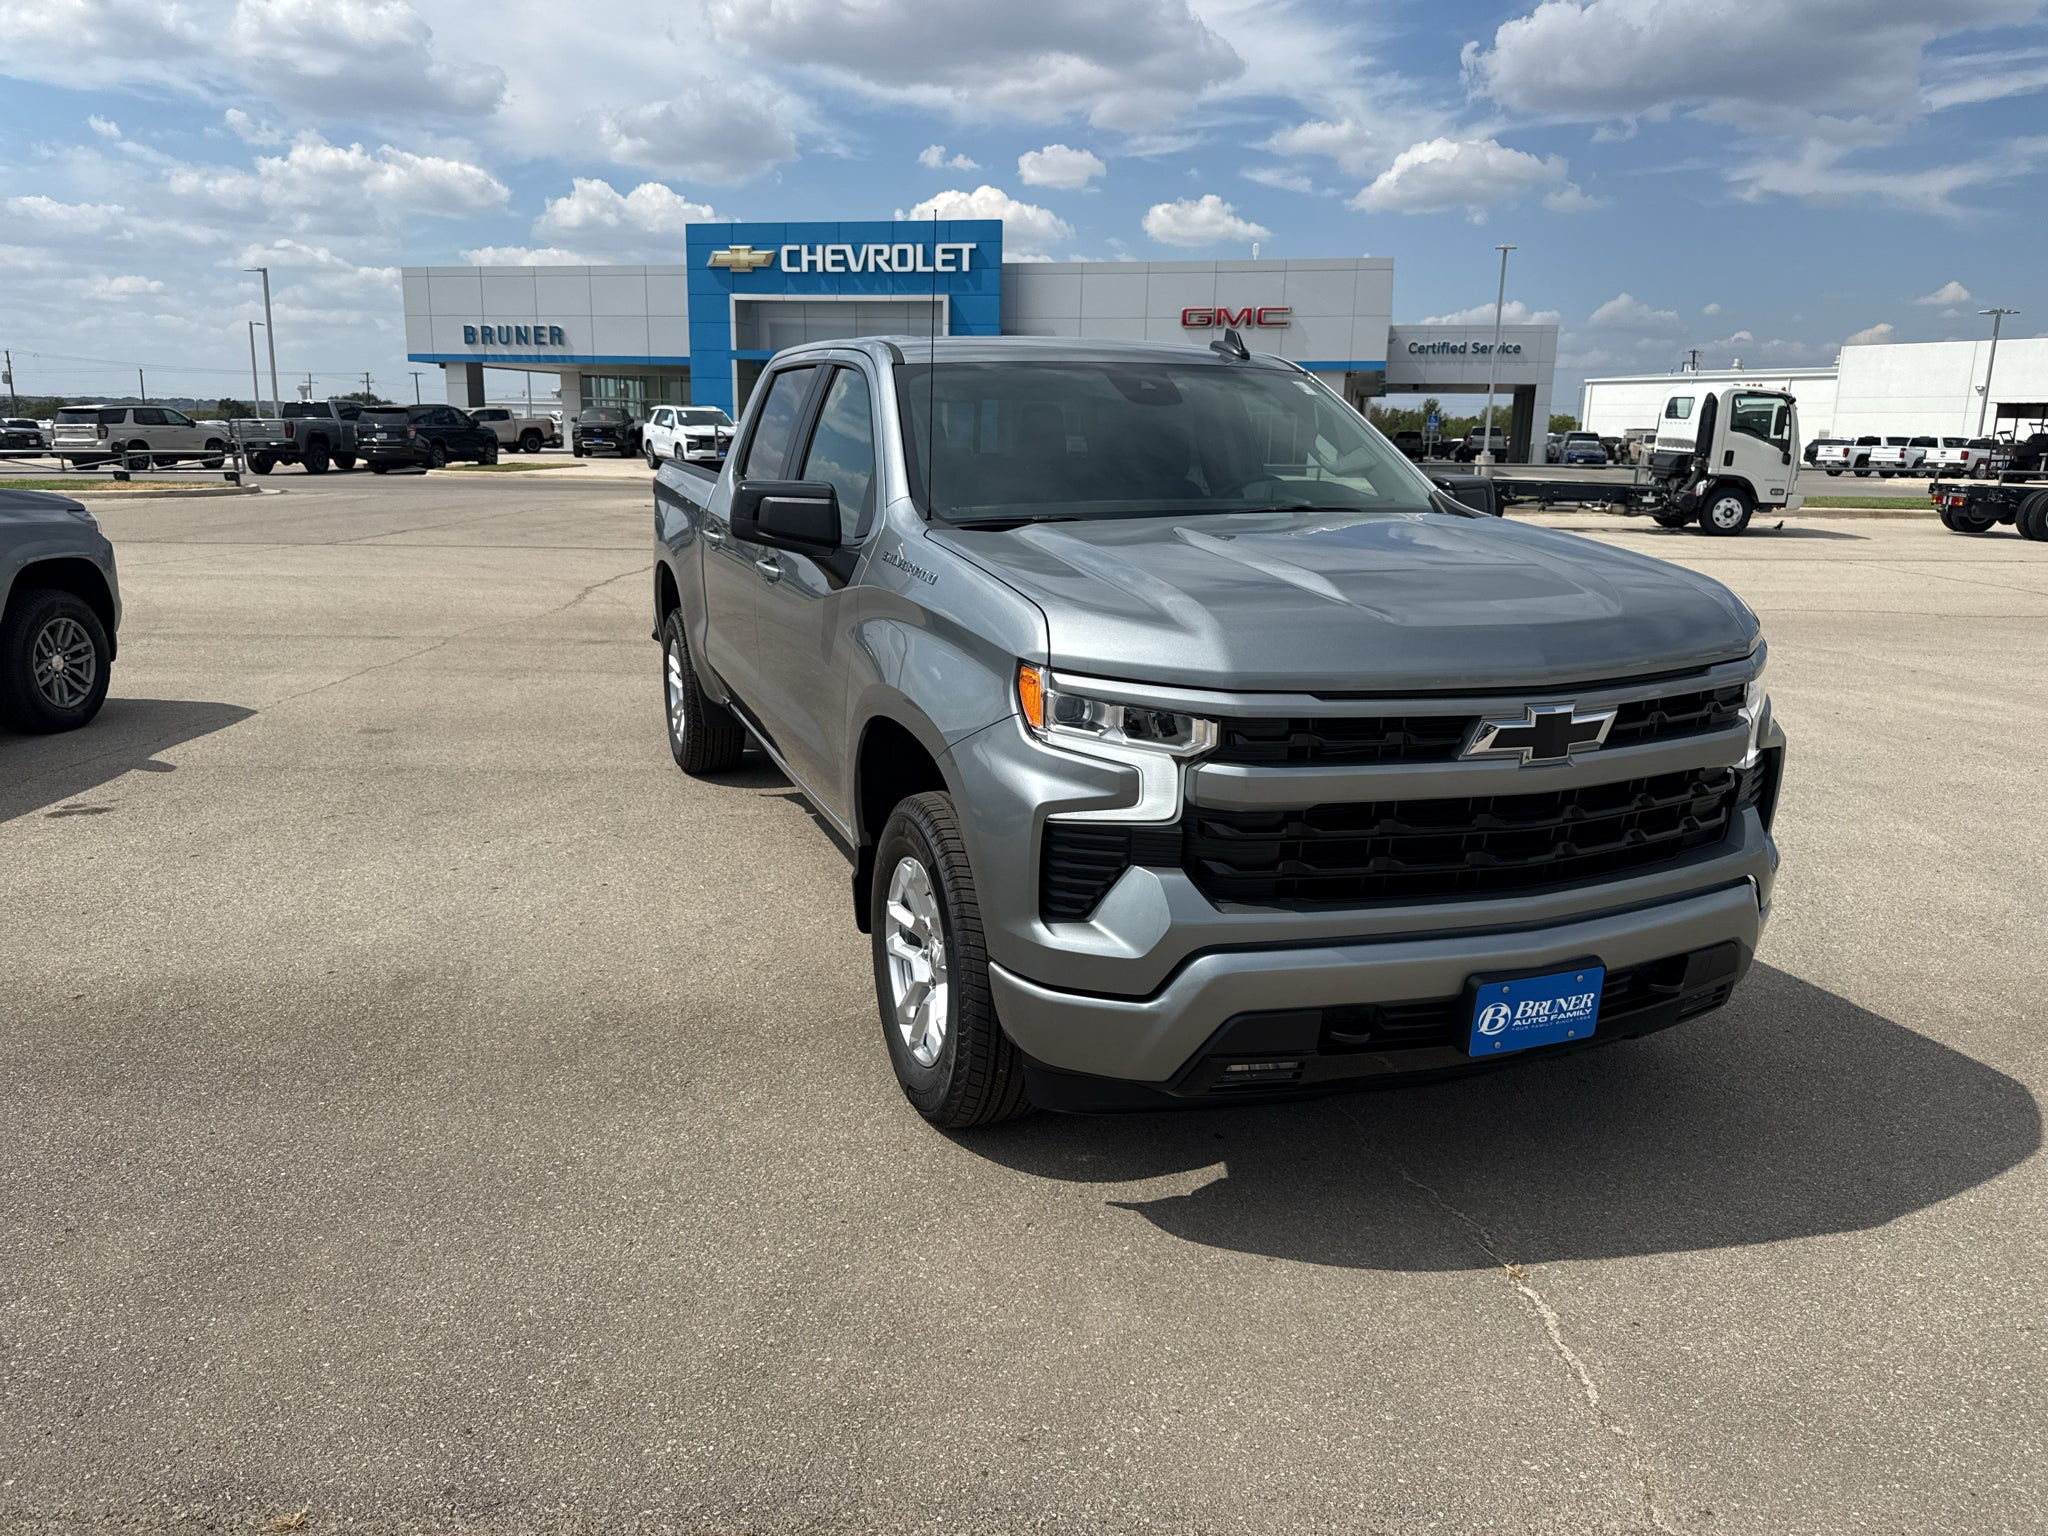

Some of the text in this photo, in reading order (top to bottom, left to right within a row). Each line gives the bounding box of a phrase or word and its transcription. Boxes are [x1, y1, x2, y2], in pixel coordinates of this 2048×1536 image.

[780, 243, 977, 273] CHEVROLET
[1181, 306, 1292, 329] GMC
[463, 325, 565, 346] BRUNER
[1408, 341, 1467, 354] Certified
[1514, 992, 1595, 1019] BRUNER
[1477, 1005, 1509, 1034] B
[1512, 1008, 1593, 1027] AUTO FAMILY
